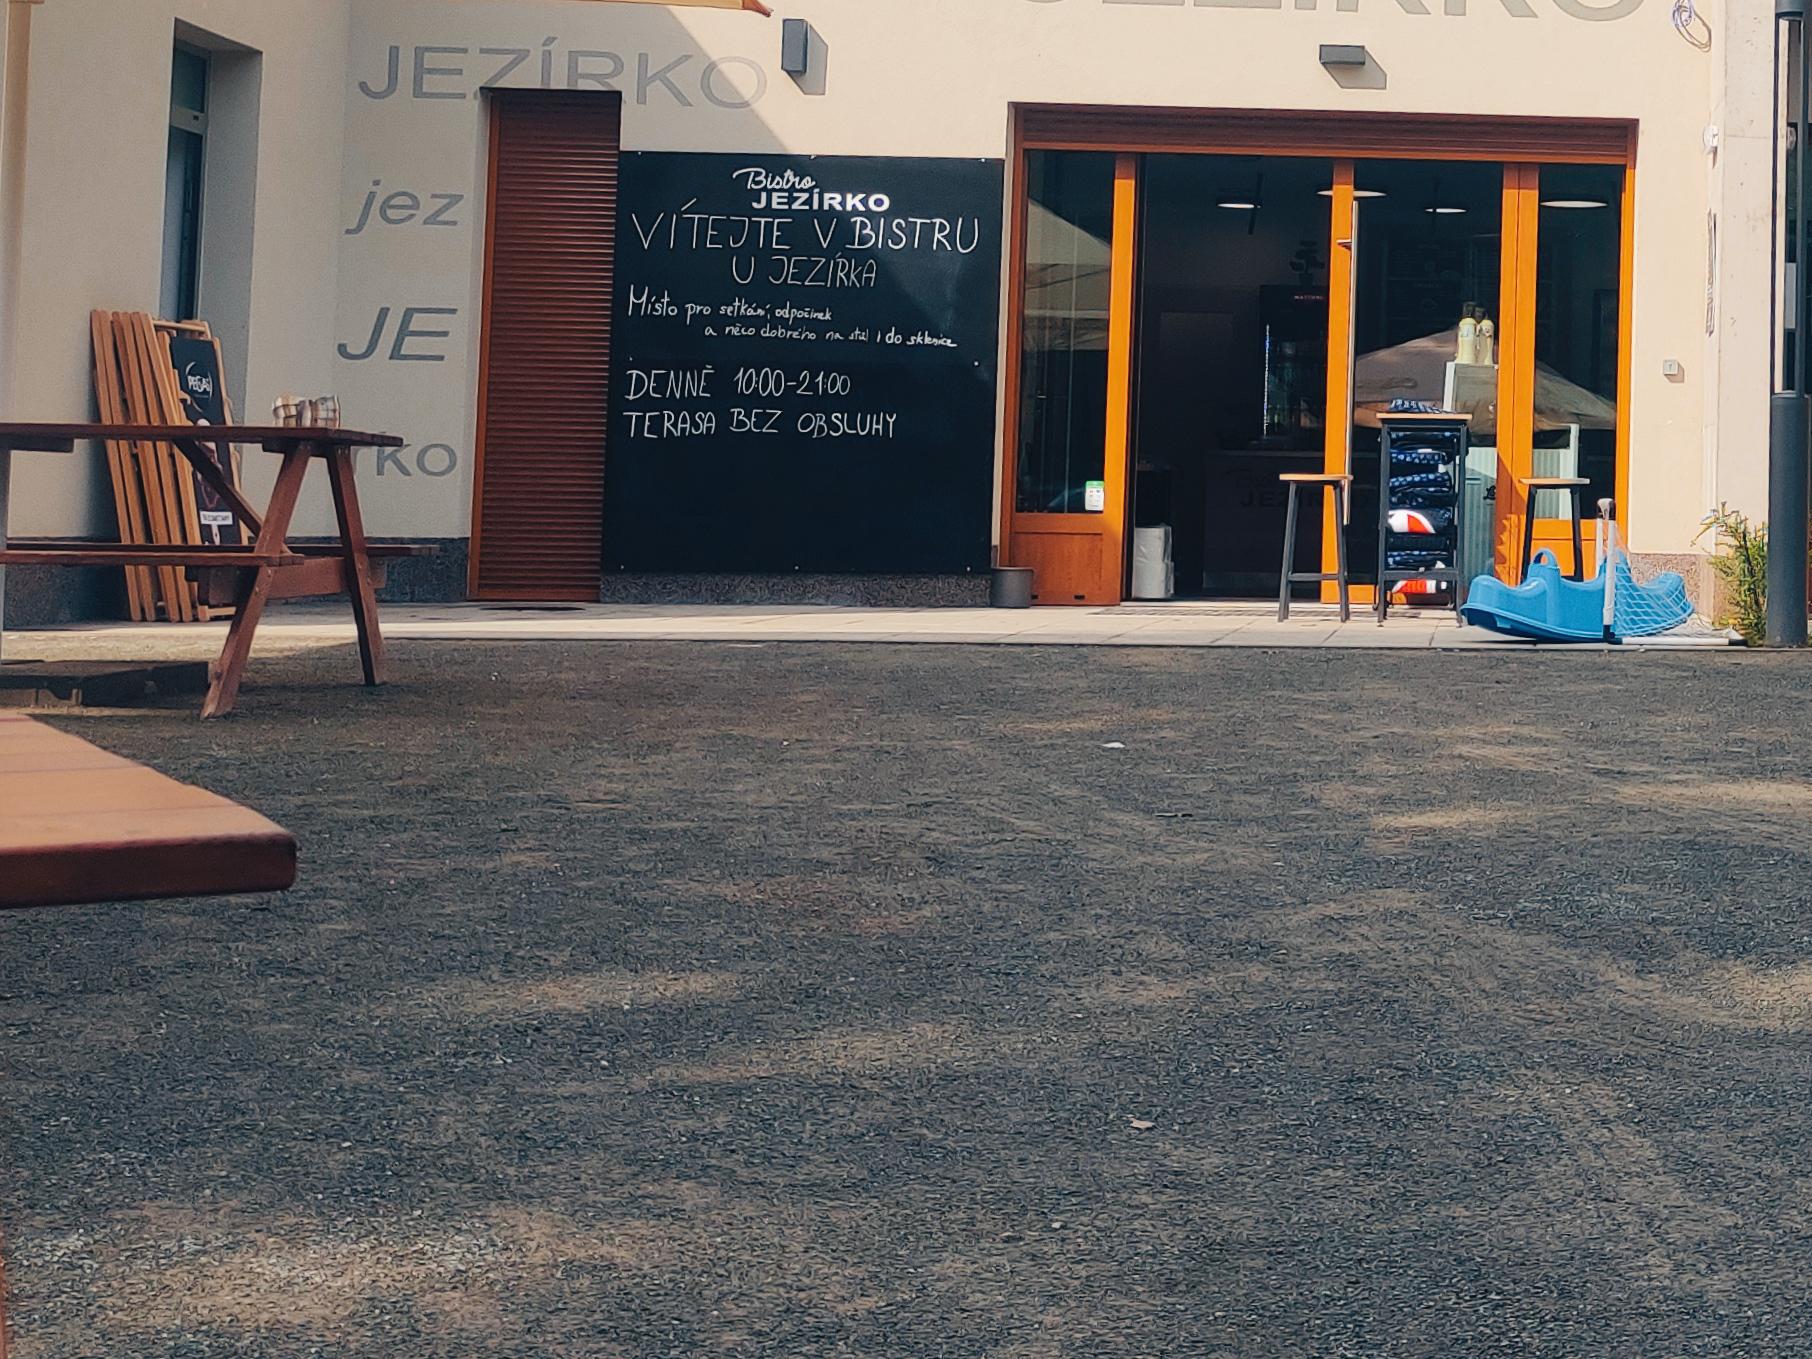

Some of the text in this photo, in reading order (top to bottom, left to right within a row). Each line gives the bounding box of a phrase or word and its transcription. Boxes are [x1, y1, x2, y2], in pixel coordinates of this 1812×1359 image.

[358, 36, 768, 110] JEZÍRKO
[732, 167, 817, 191] Bistro
[345, 179, 464, 235] jez
[751, 190, 890, 212] JEZÍRKO
[631, 198, 980, 253] VÍTEJTE V BISTRU
[732, 251, 877, 288] U JEZÍRKA
[628, 284, 678, 317] Místo
[685, 303, 711, 325] pro
[337, 307, 458, 362] JE
[704, 325, 717, 336] a
[725, 323, 756, 336] něco
[760, 323, 817, 341] dobrého
[825, 331, 844, 341] na
[885, 326, 903, 345] do
[624, 365, 715, 400] DENNĚ
[622, 408, 897, 438] TERASA BEZ OBSLUHY
